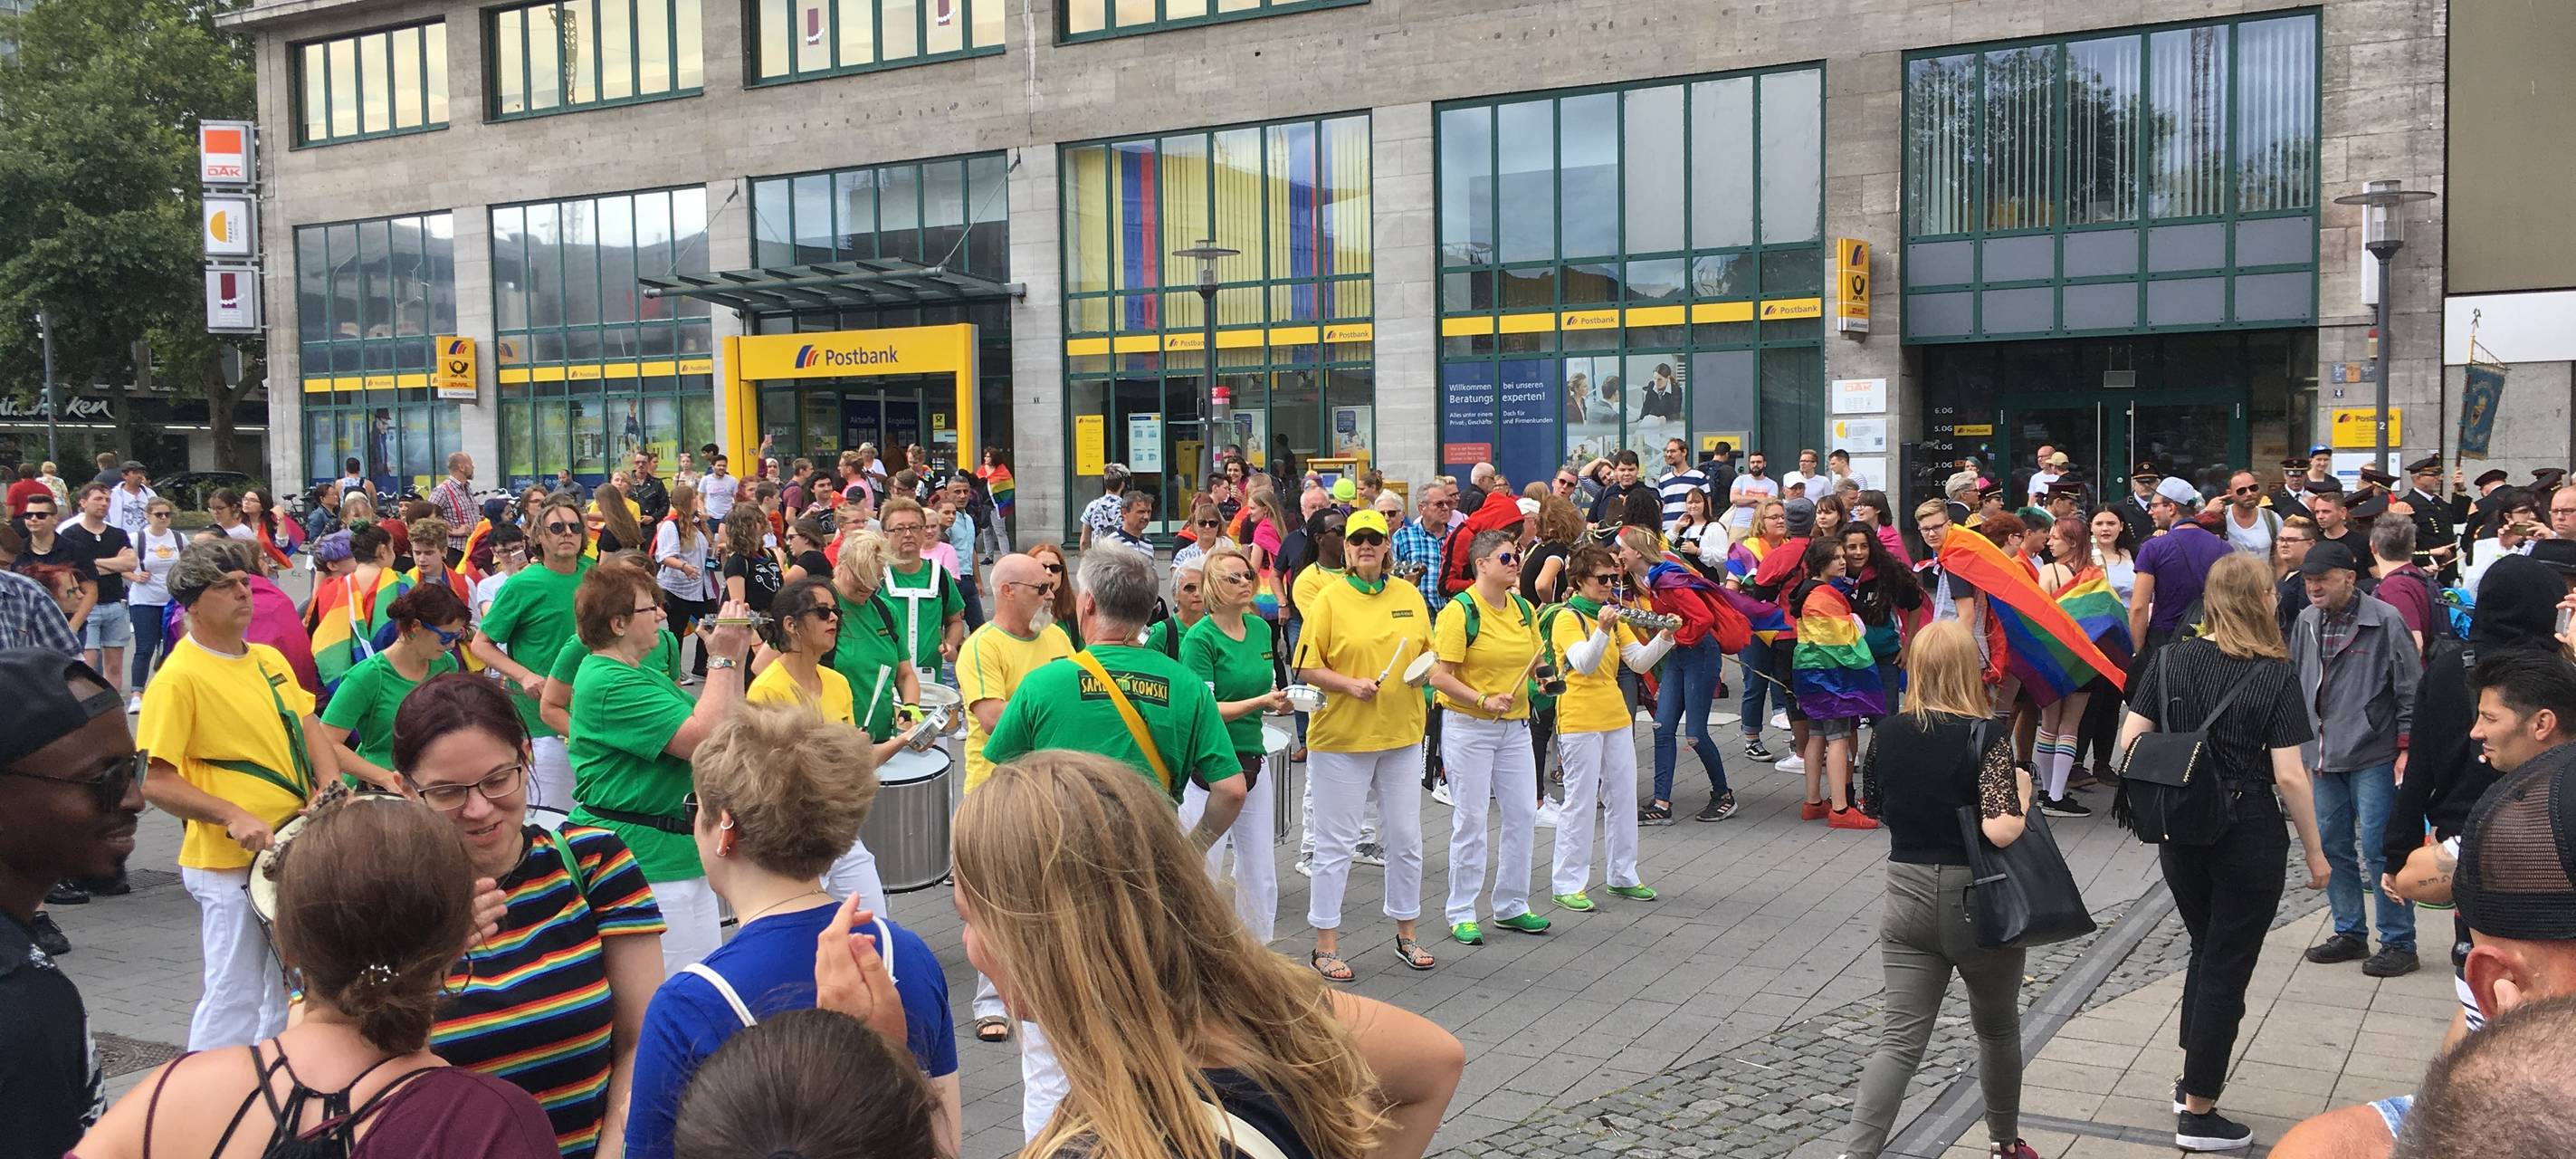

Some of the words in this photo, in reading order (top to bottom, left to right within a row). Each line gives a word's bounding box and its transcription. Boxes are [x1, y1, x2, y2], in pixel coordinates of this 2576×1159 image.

[207, 165, 241, 177] DAK
[1779, 304, 1818, 314] Postbank
[1580, 316, 1616, 325] Postbank
[1339, 330, 1369, 340] Postbank
[1180, 339, 1206, 347] Postban
[825, 345, 898, 366] Postbank
[1503, 381, 1513, 389] bei
[1449, 394, 1493, 405] Beratungs
[1502, 391, 1546, 403] experten!
[2379, 422, 2386, 430] 2
